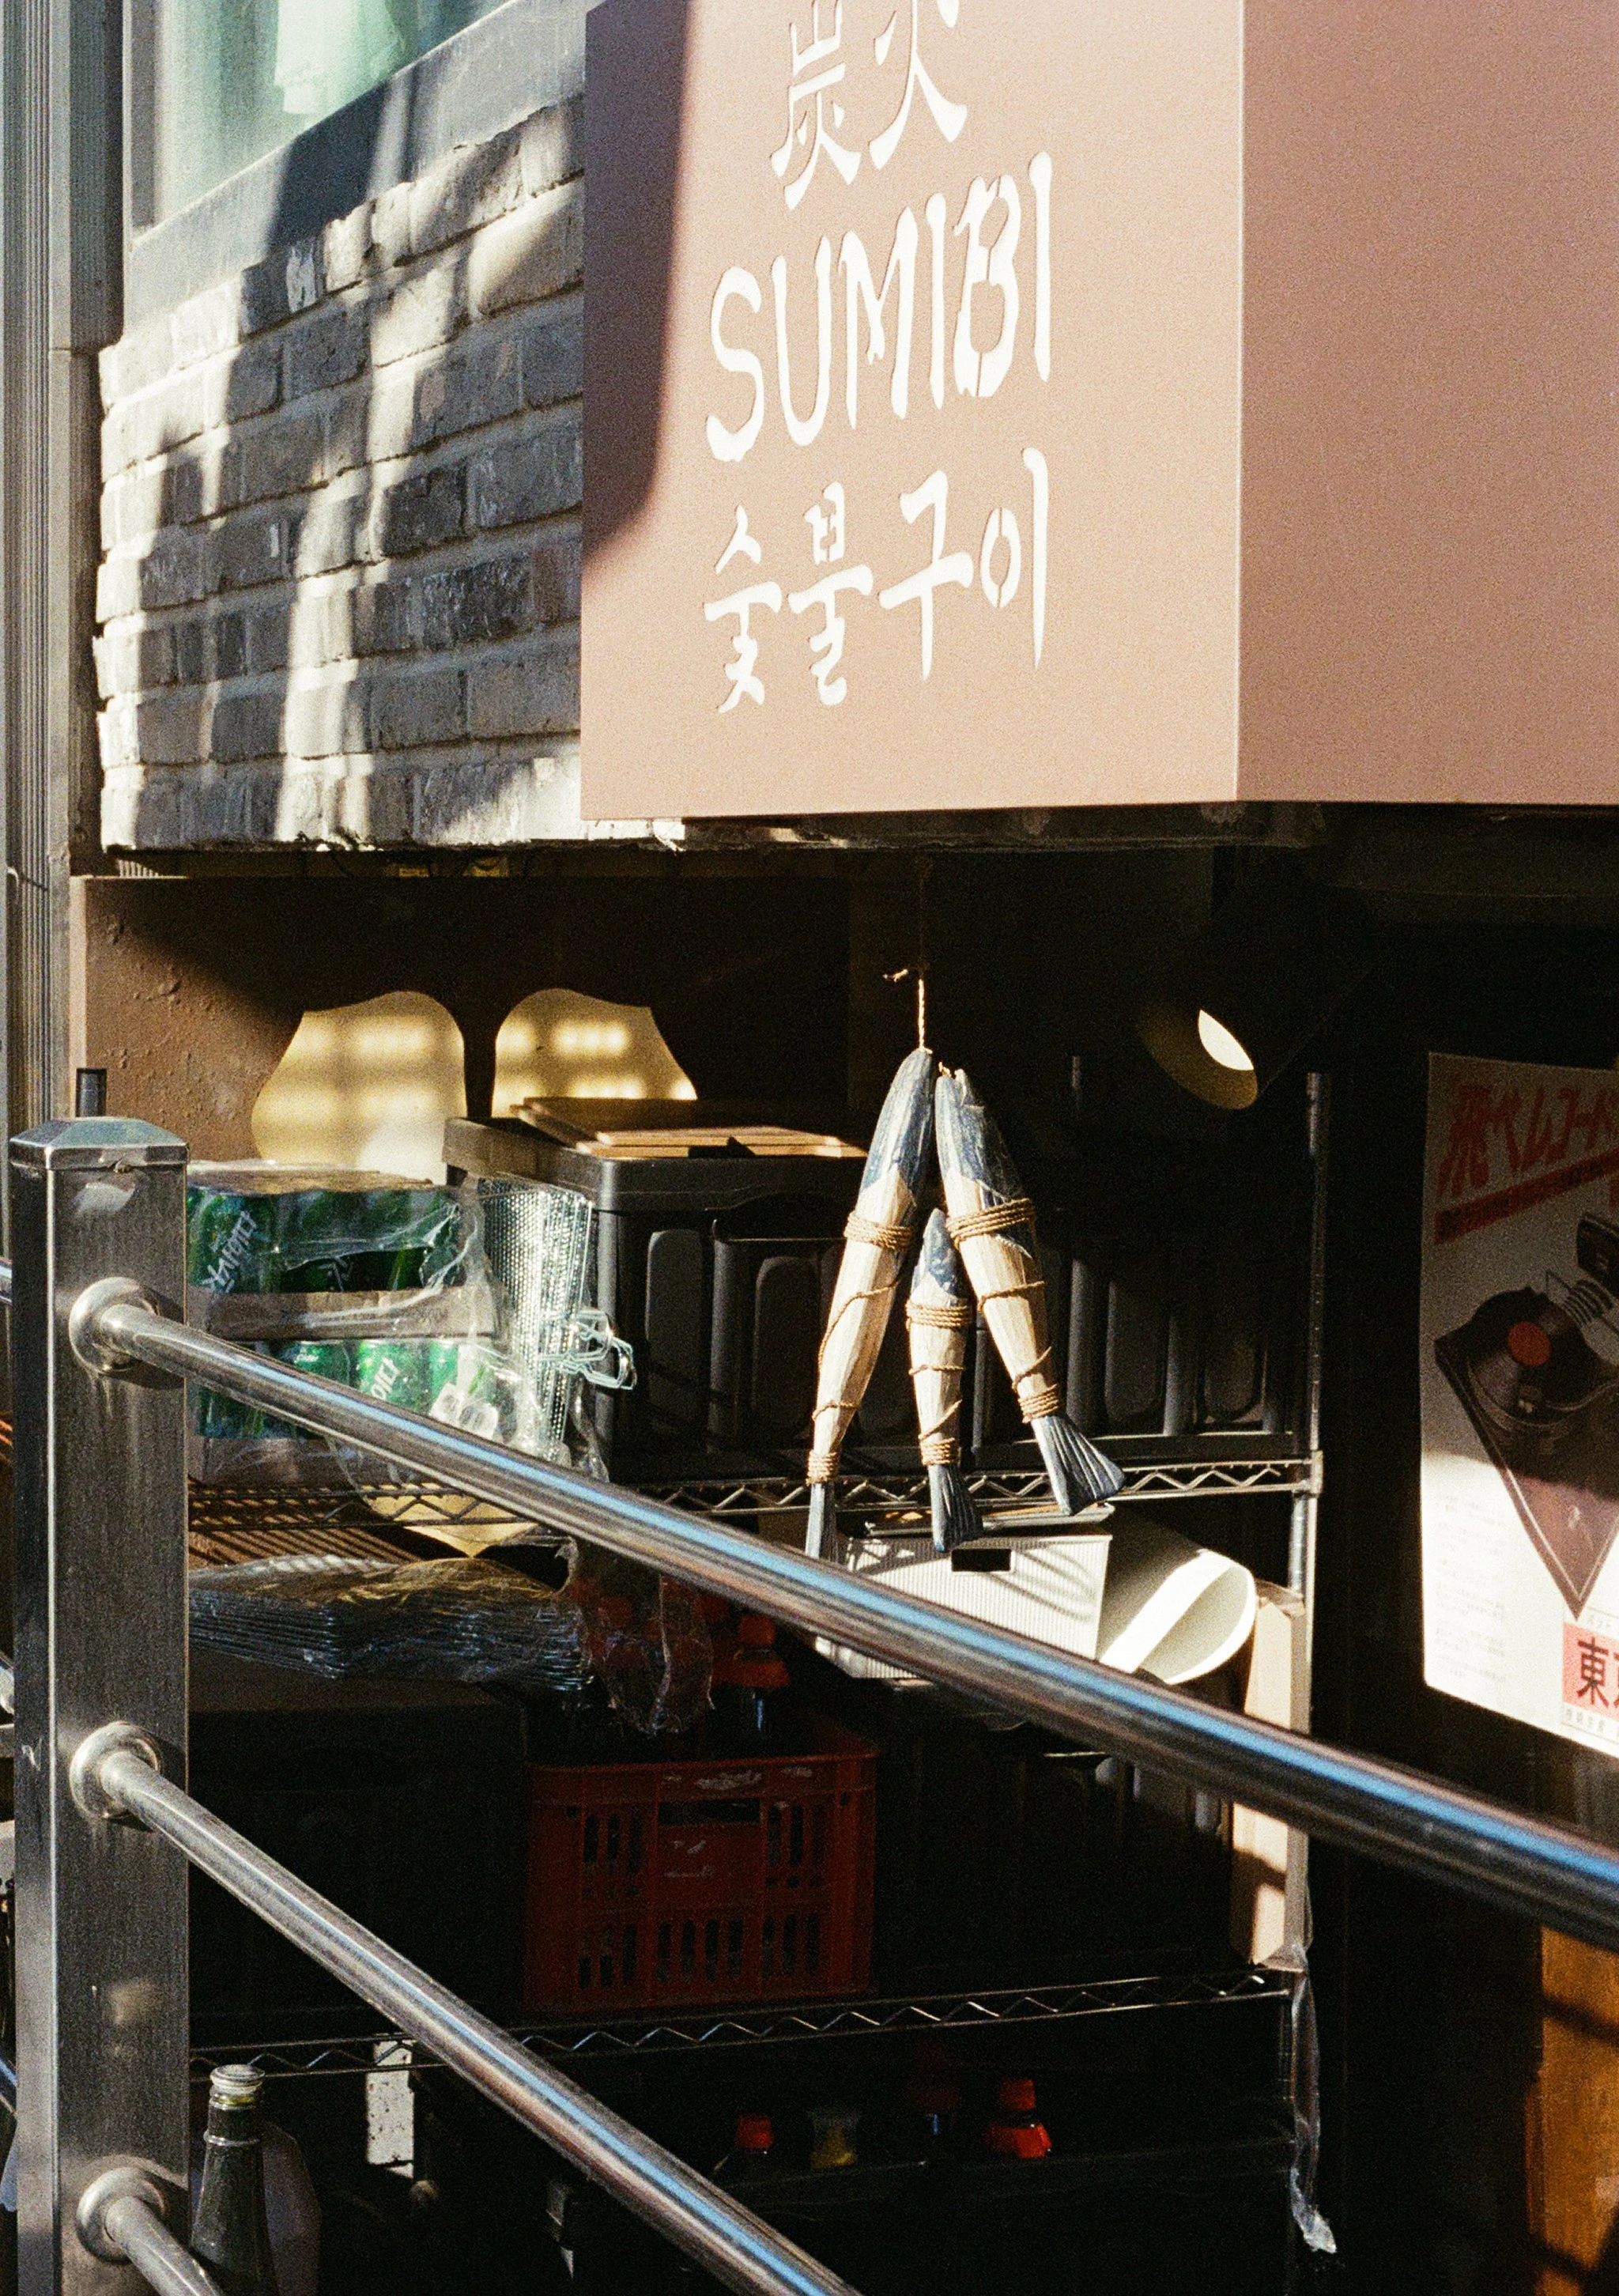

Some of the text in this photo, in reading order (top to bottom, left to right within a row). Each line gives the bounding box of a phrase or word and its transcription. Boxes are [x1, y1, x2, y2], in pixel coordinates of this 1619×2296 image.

[770, 0, 968, 210] 炭火
[706, 151, 1052, 463] SUMIBI
[704, 447, 1049, 713] 숯불구이
